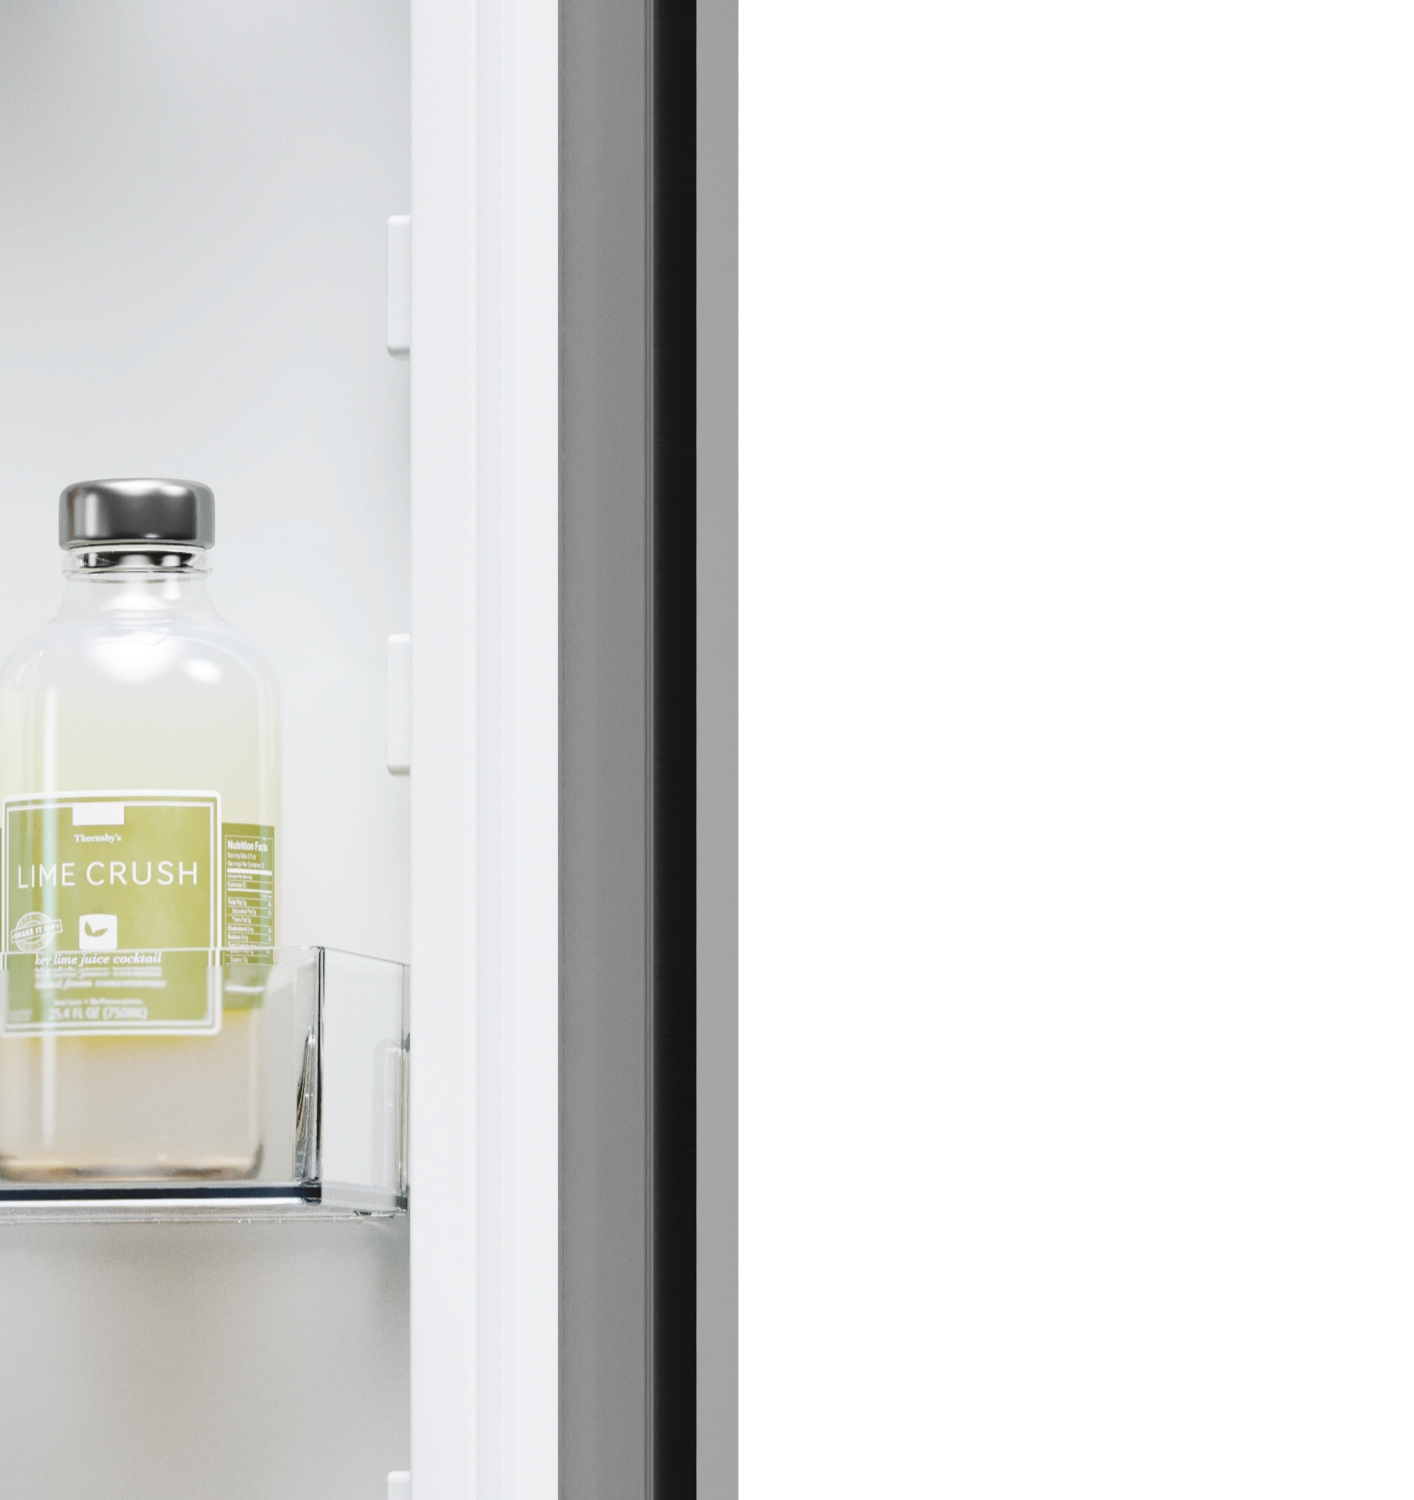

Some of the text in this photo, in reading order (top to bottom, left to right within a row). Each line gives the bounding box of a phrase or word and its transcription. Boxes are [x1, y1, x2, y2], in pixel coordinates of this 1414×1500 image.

[73, 832, 122, 844] Thornsby's
[227, 839, 268, 852] Nutrition Facts
[18, 860, 198, 889] LIME CRUSH
[14, 923, 56, 940] SHAKE IT UP
[34, 951, 163, 968] key lime juice cocktail
